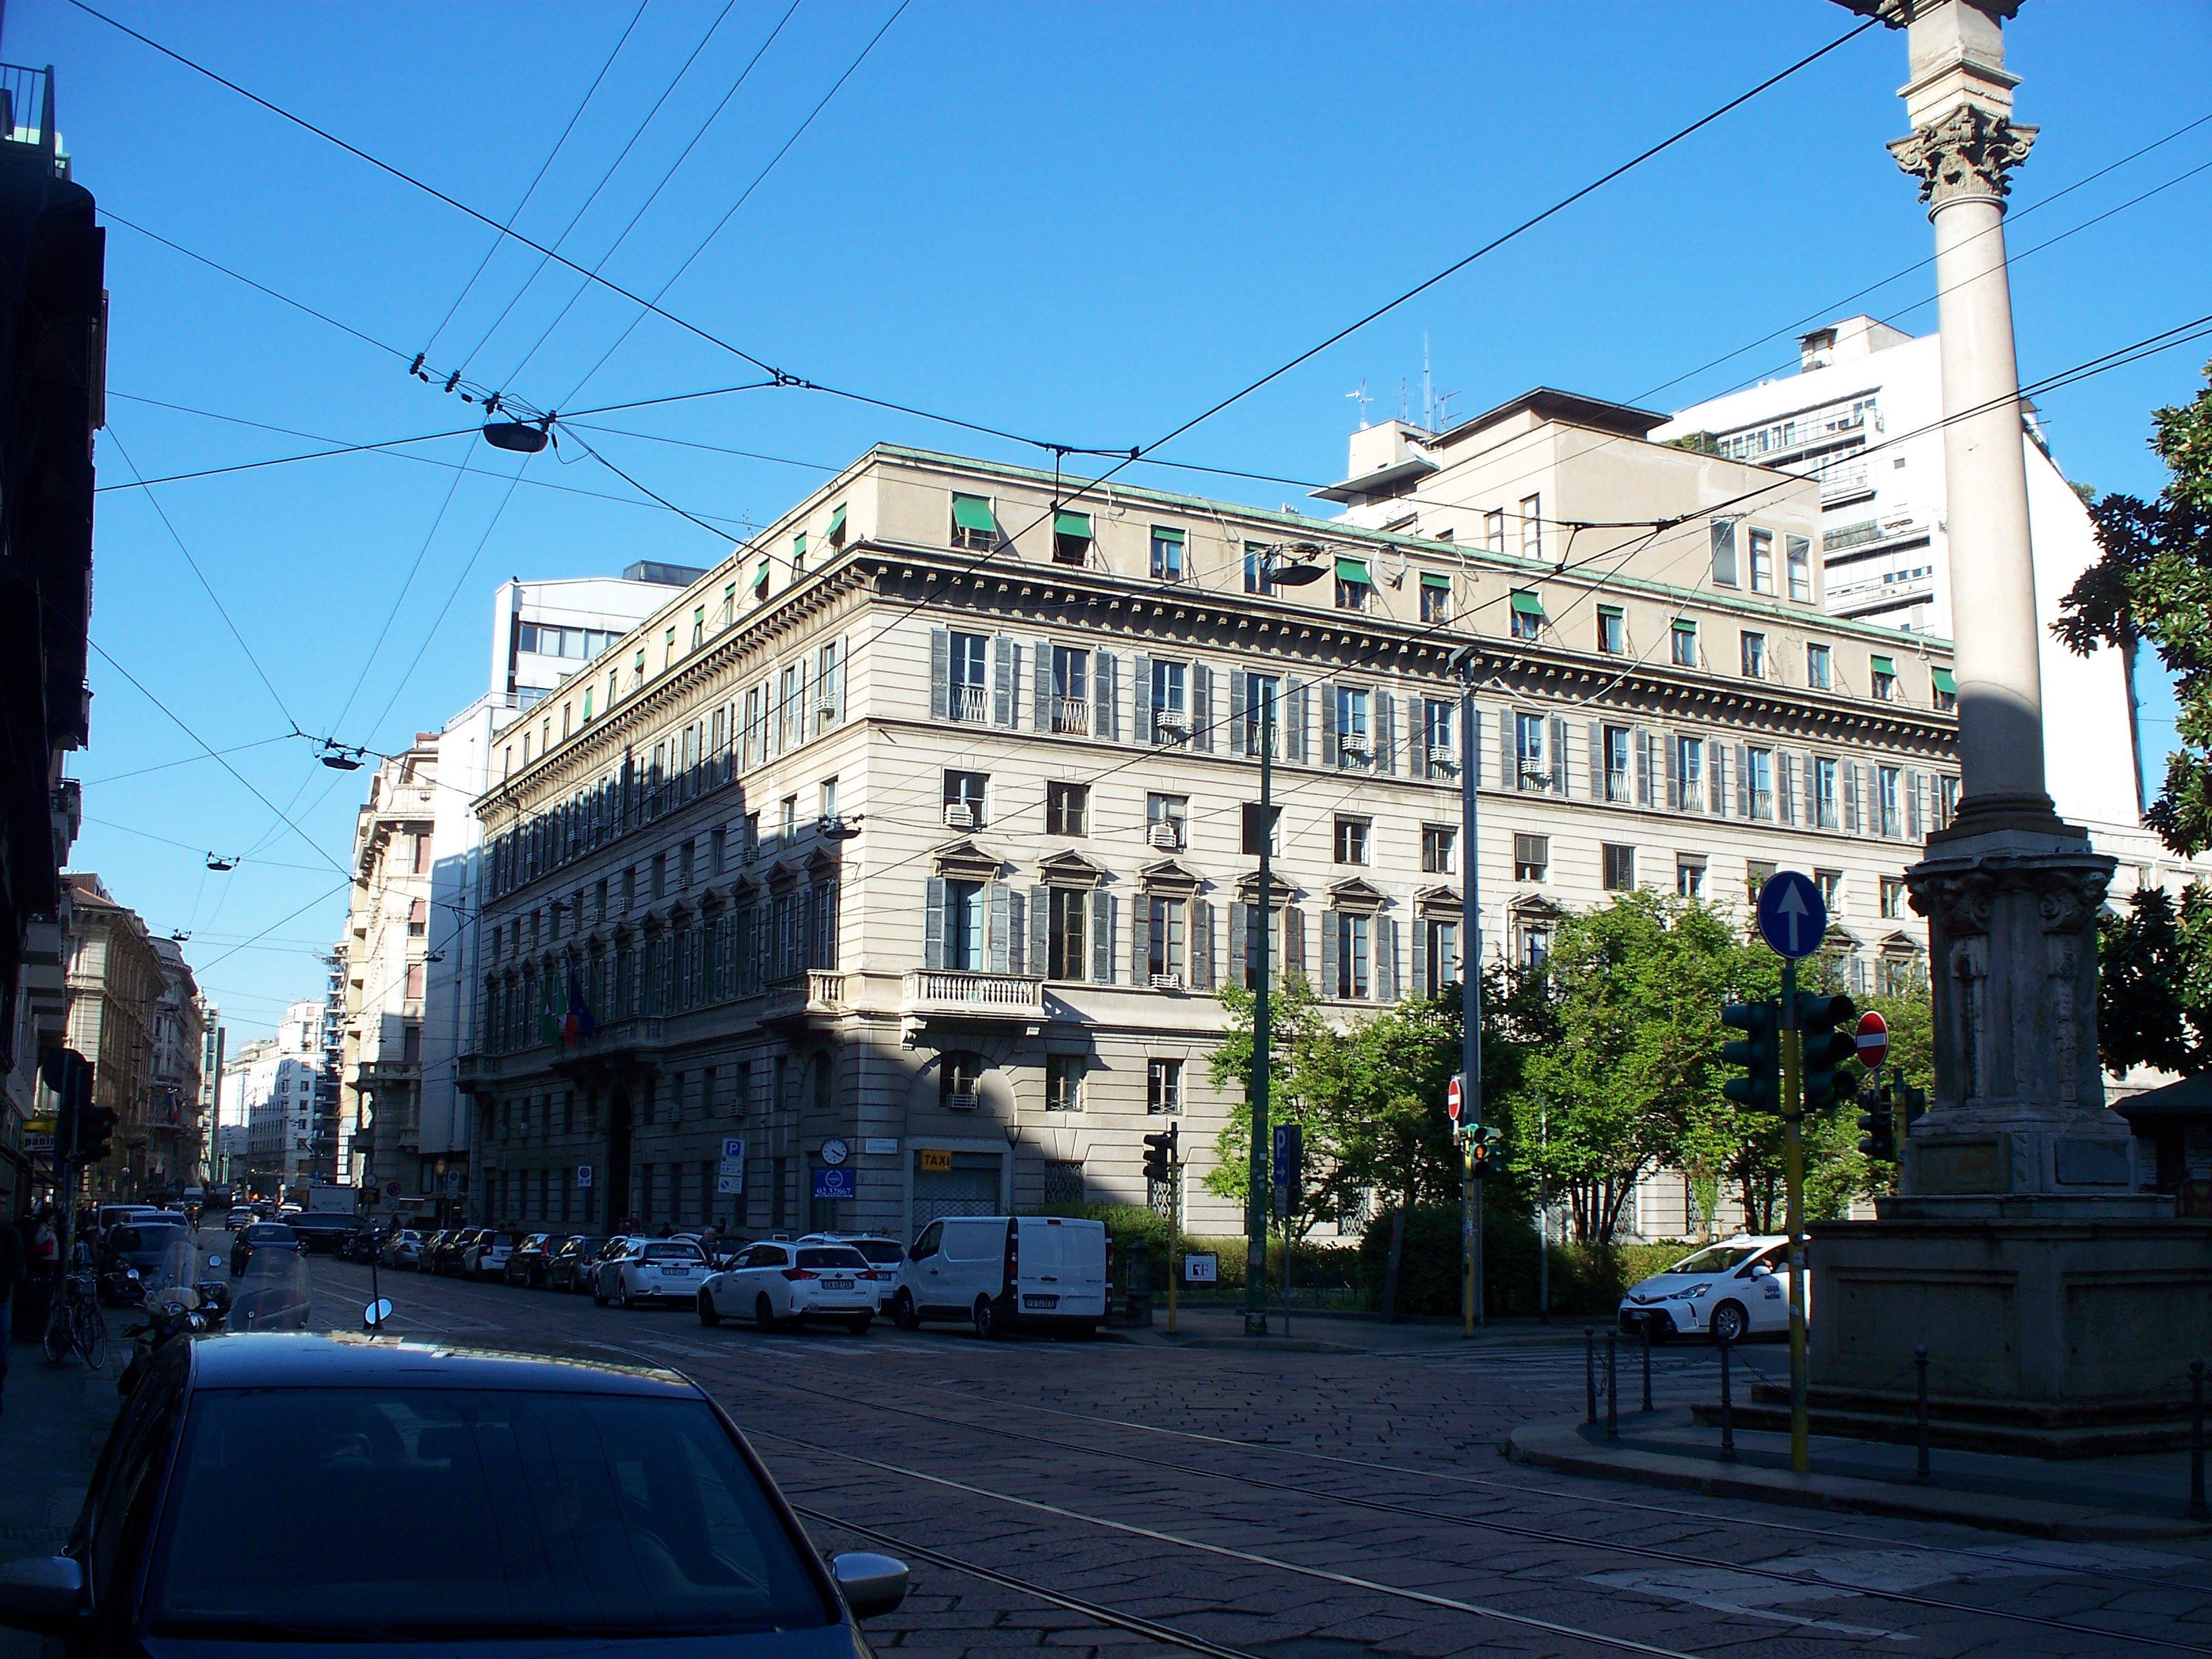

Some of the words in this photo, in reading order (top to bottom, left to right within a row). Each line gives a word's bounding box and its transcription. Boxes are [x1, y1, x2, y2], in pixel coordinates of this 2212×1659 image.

[729, 1142, 738, 1154] P
[1276, 1129, 1286, 1158] P
[924, 1155, 949, 1166] TAXI
